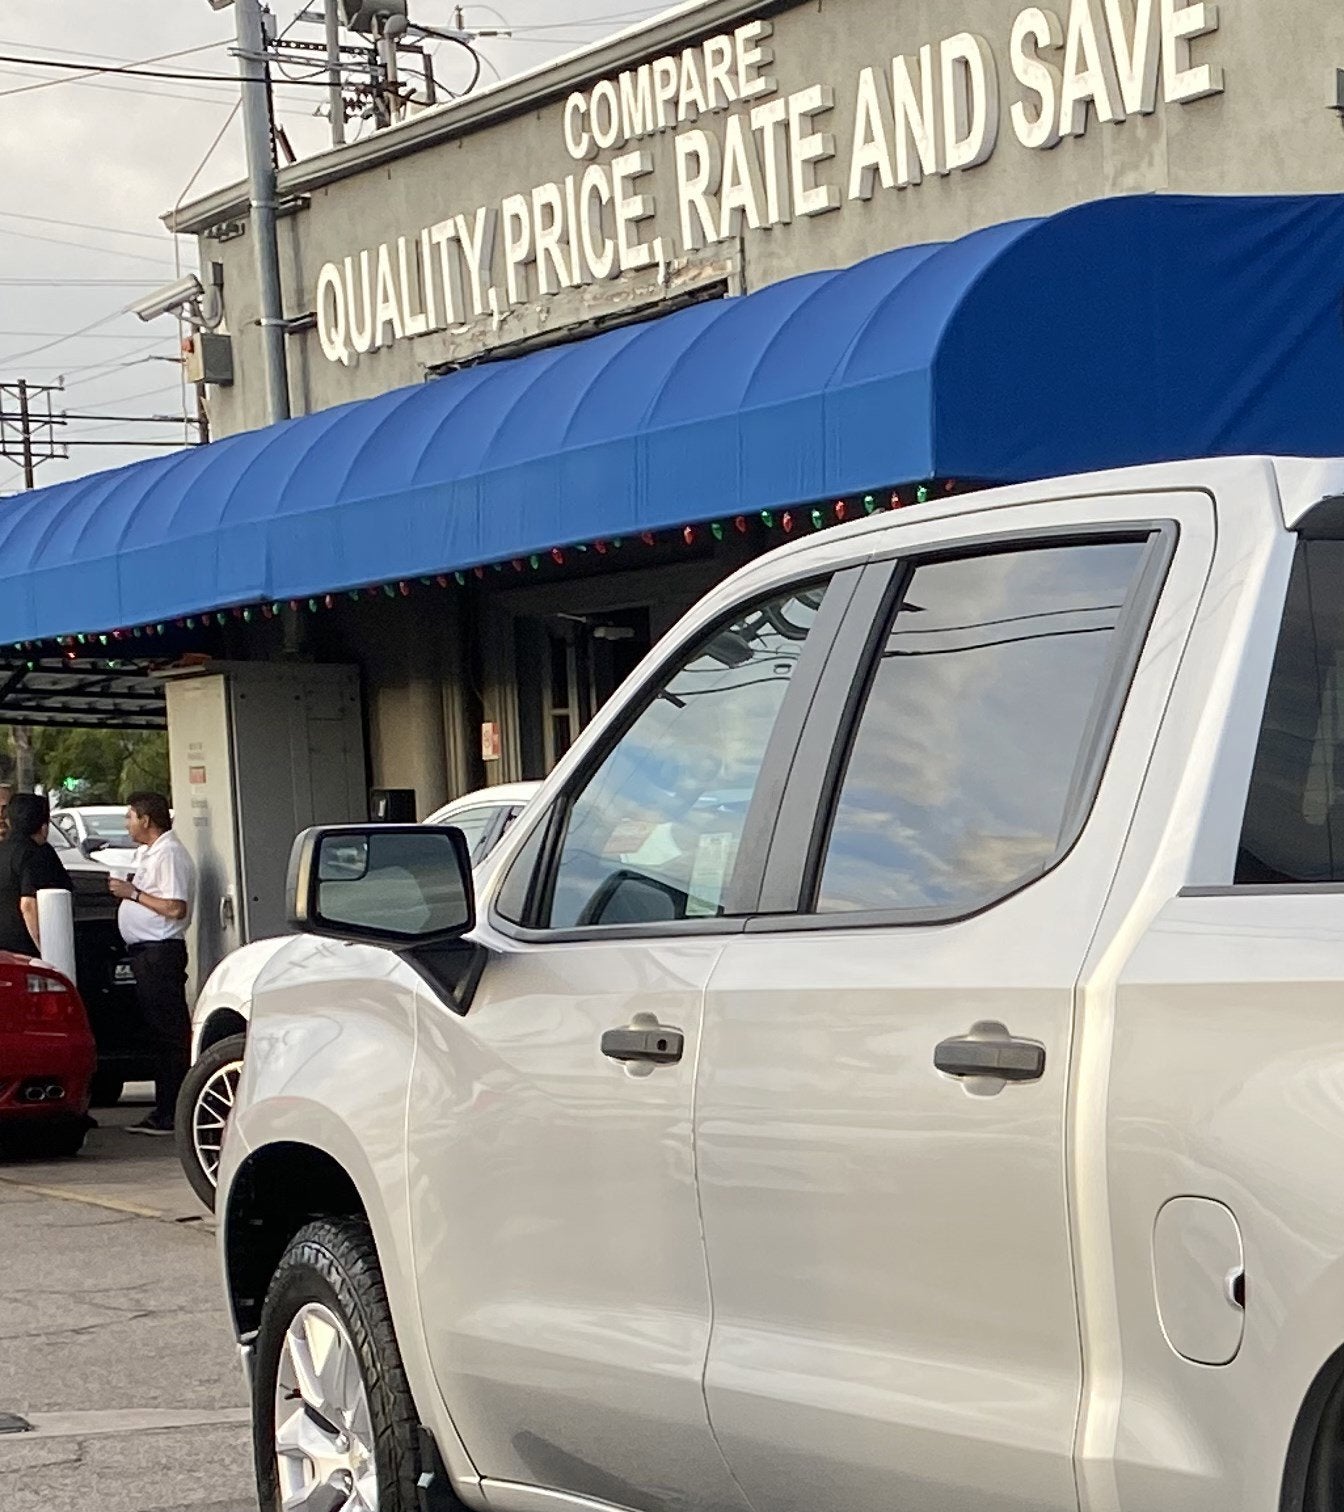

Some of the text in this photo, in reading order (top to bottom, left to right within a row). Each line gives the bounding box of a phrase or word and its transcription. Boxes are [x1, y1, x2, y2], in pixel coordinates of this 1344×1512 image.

[316, 0, 1225, 367] QUALITY, PRICE, RATE AND SAVE
[564, 19, 777, 159] COMPARE
